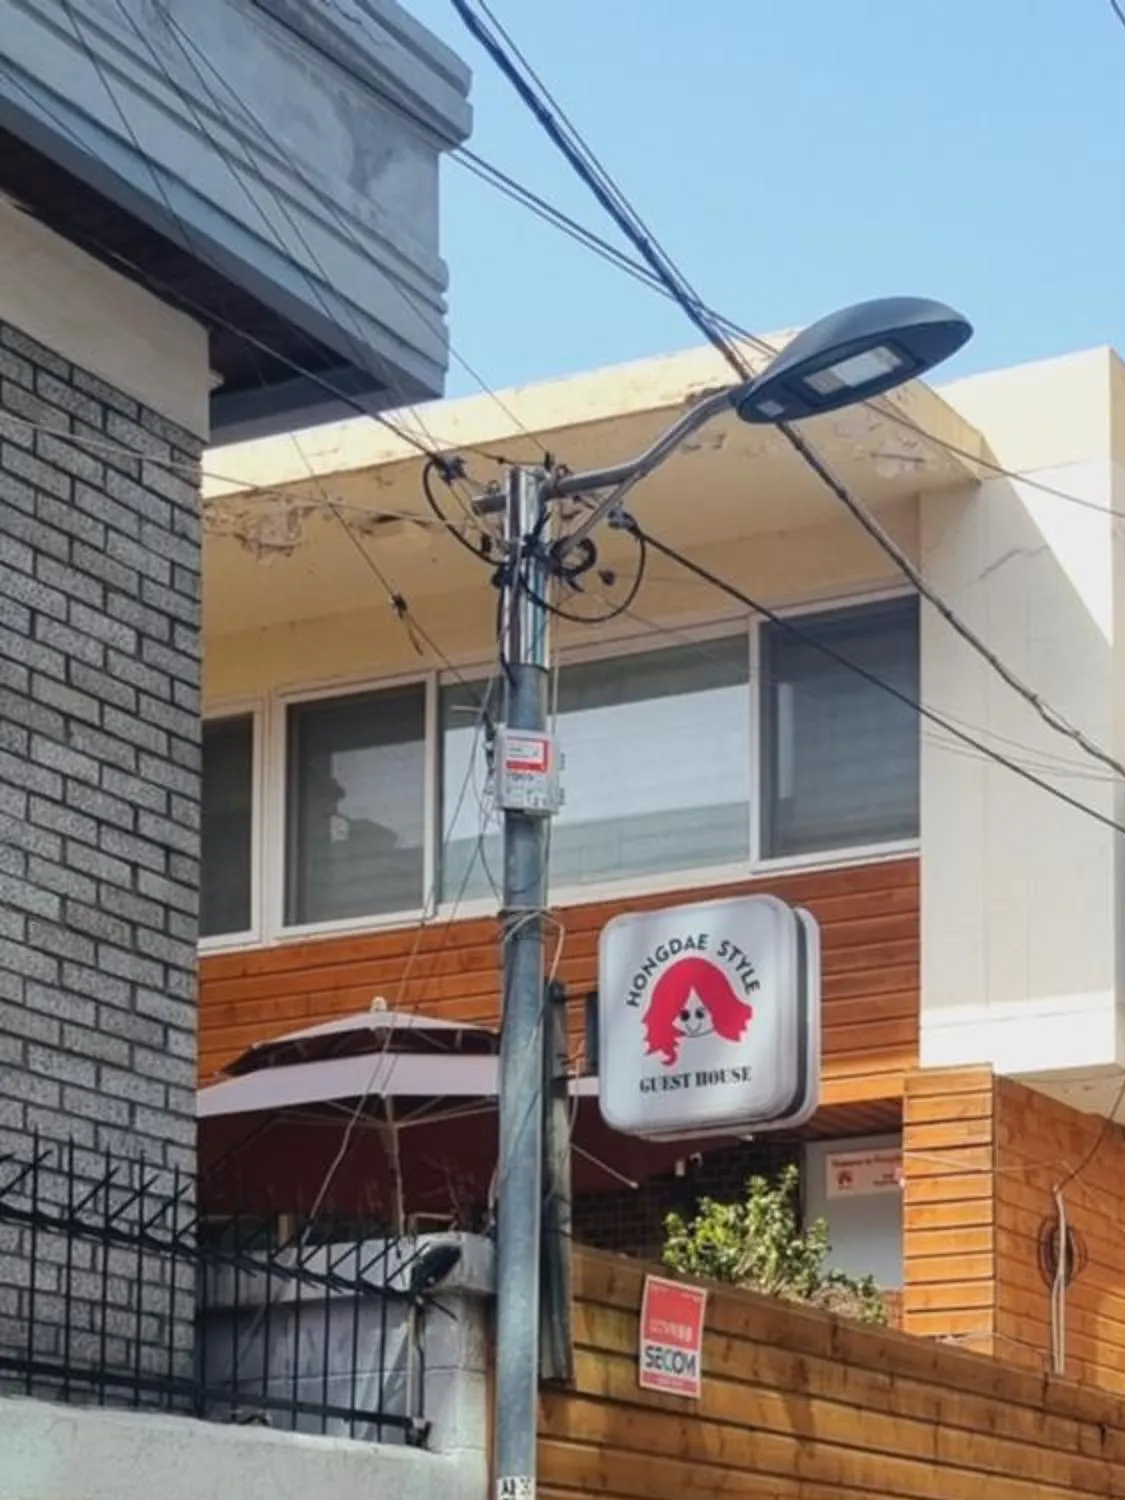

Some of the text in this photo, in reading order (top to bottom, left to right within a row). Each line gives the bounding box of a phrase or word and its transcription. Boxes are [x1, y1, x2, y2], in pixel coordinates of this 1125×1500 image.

[626, 933, 761, 1008] HONGDAE STYLE
[639, 1066, 752, 1094] GUEST HOUSE
[645, 1344, 696, 1377] SECOM
